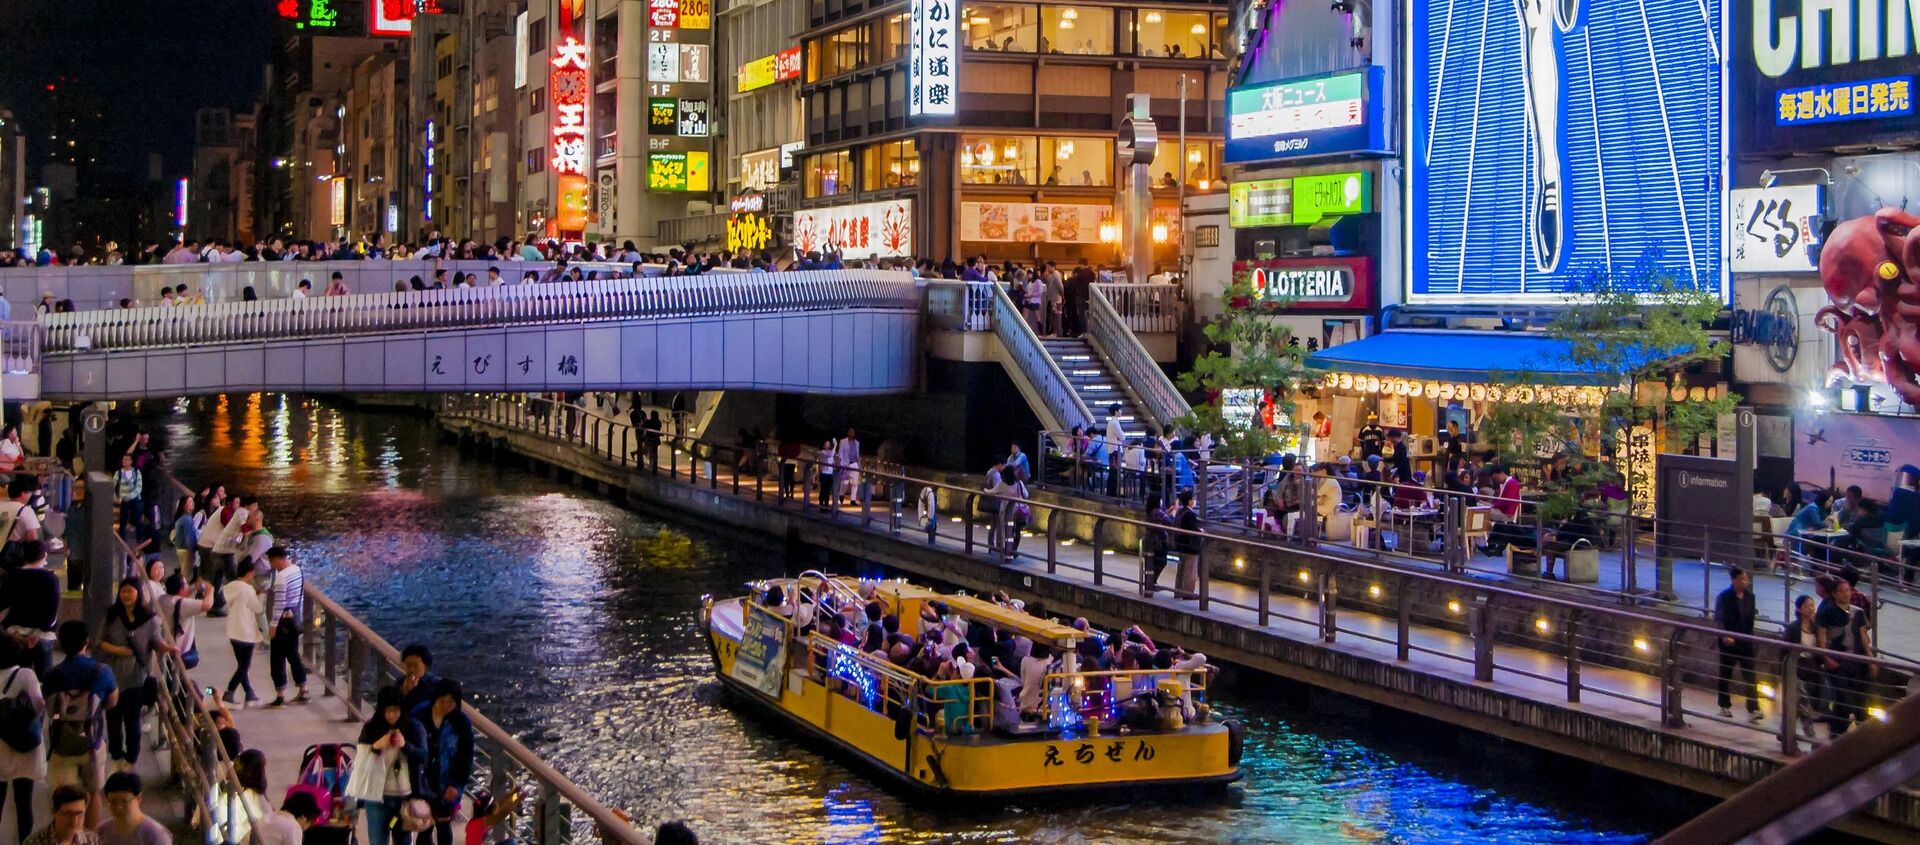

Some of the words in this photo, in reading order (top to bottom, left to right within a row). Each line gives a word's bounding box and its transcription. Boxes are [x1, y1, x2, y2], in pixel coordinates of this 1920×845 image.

[651, 30, 672, 42] 2F
[651, 84, 671, 96] 1F
[1779, 80, 1909, 121] 毎週水曜日発売
[689, 112, 699, 122] の
[681, 120, 706, 135] 青山
[652, 160, 684, 176] びっくり
[650, 173, 686, 189] ドンキー
[1269, 269, 1344, 297] LOTTERIA
[431, 354, 579, 377] えびす橋
[1690, 474, 1728, 488] information
[1043, 739, 1156, 768] えちぜん
